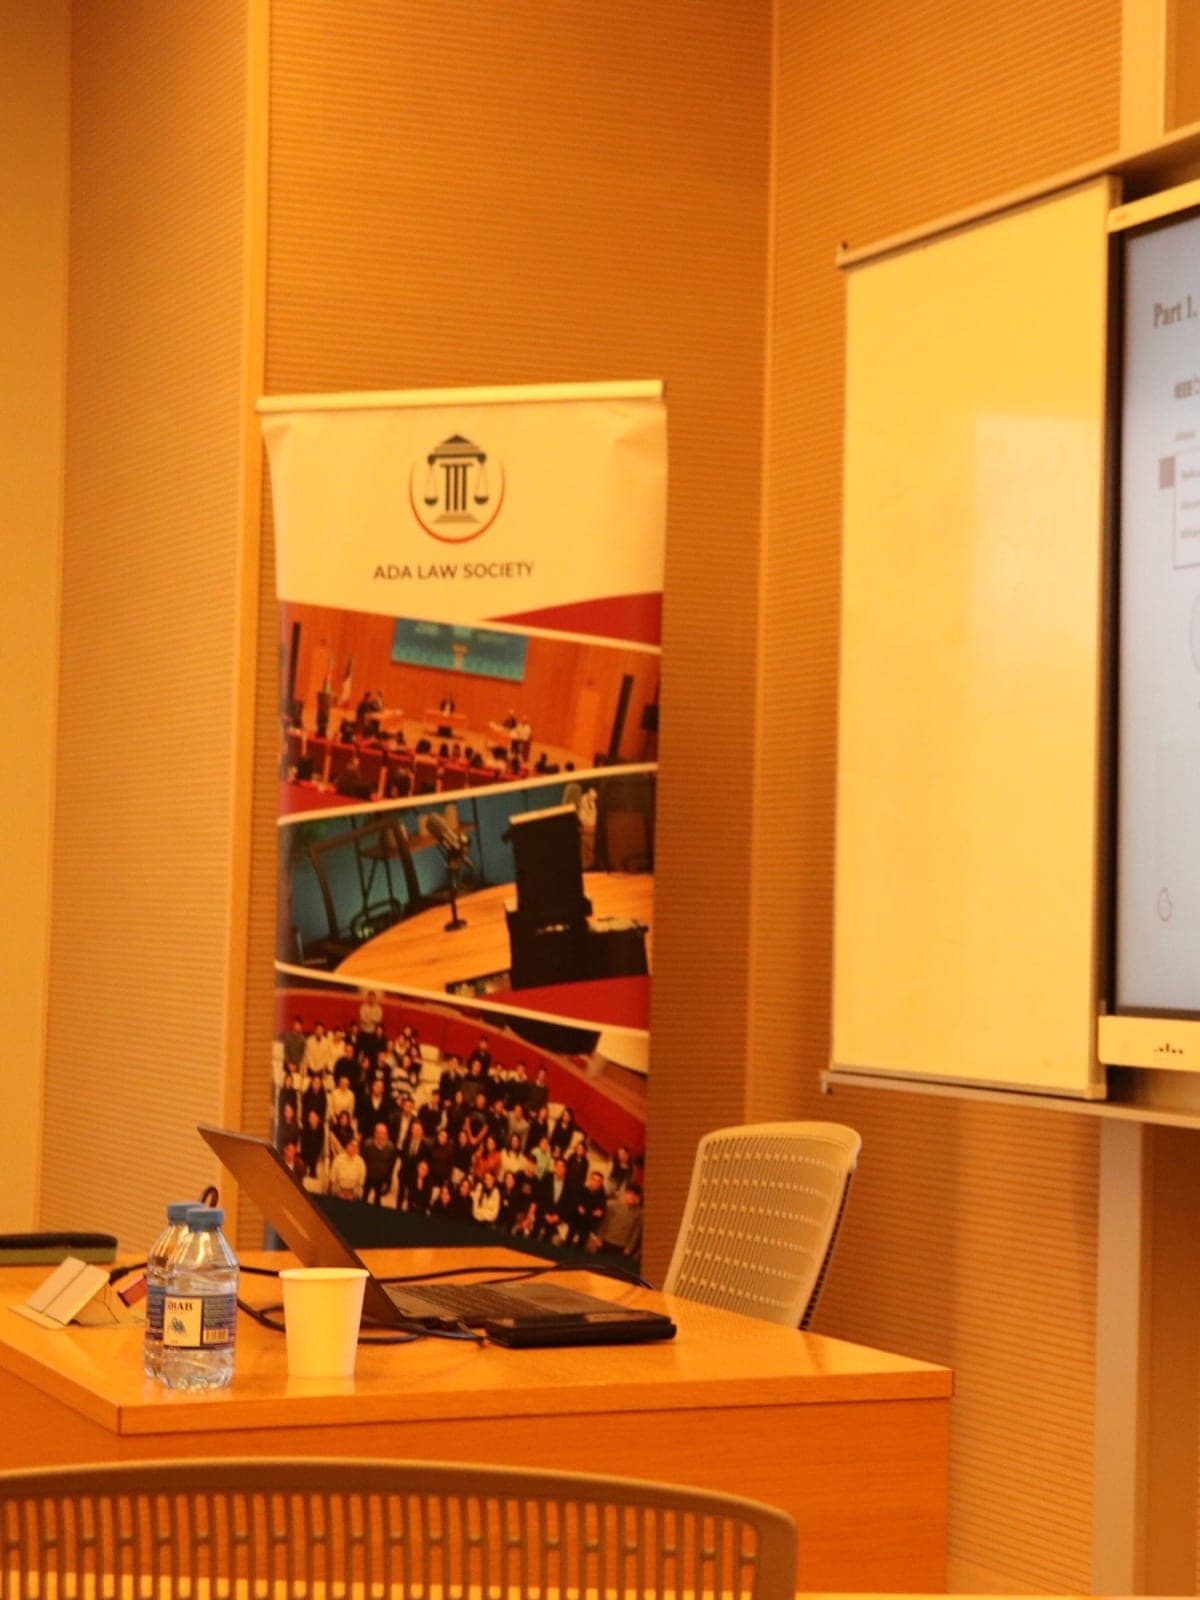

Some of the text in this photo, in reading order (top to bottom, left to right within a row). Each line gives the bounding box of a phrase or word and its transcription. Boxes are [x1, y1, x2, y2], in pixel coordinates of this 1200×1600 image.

[1153, 302, 1182, 329] Part
[1187, 295, 1198, 320] 1.
[373, 560, 535, 580] ADA LAW SOCIETY
